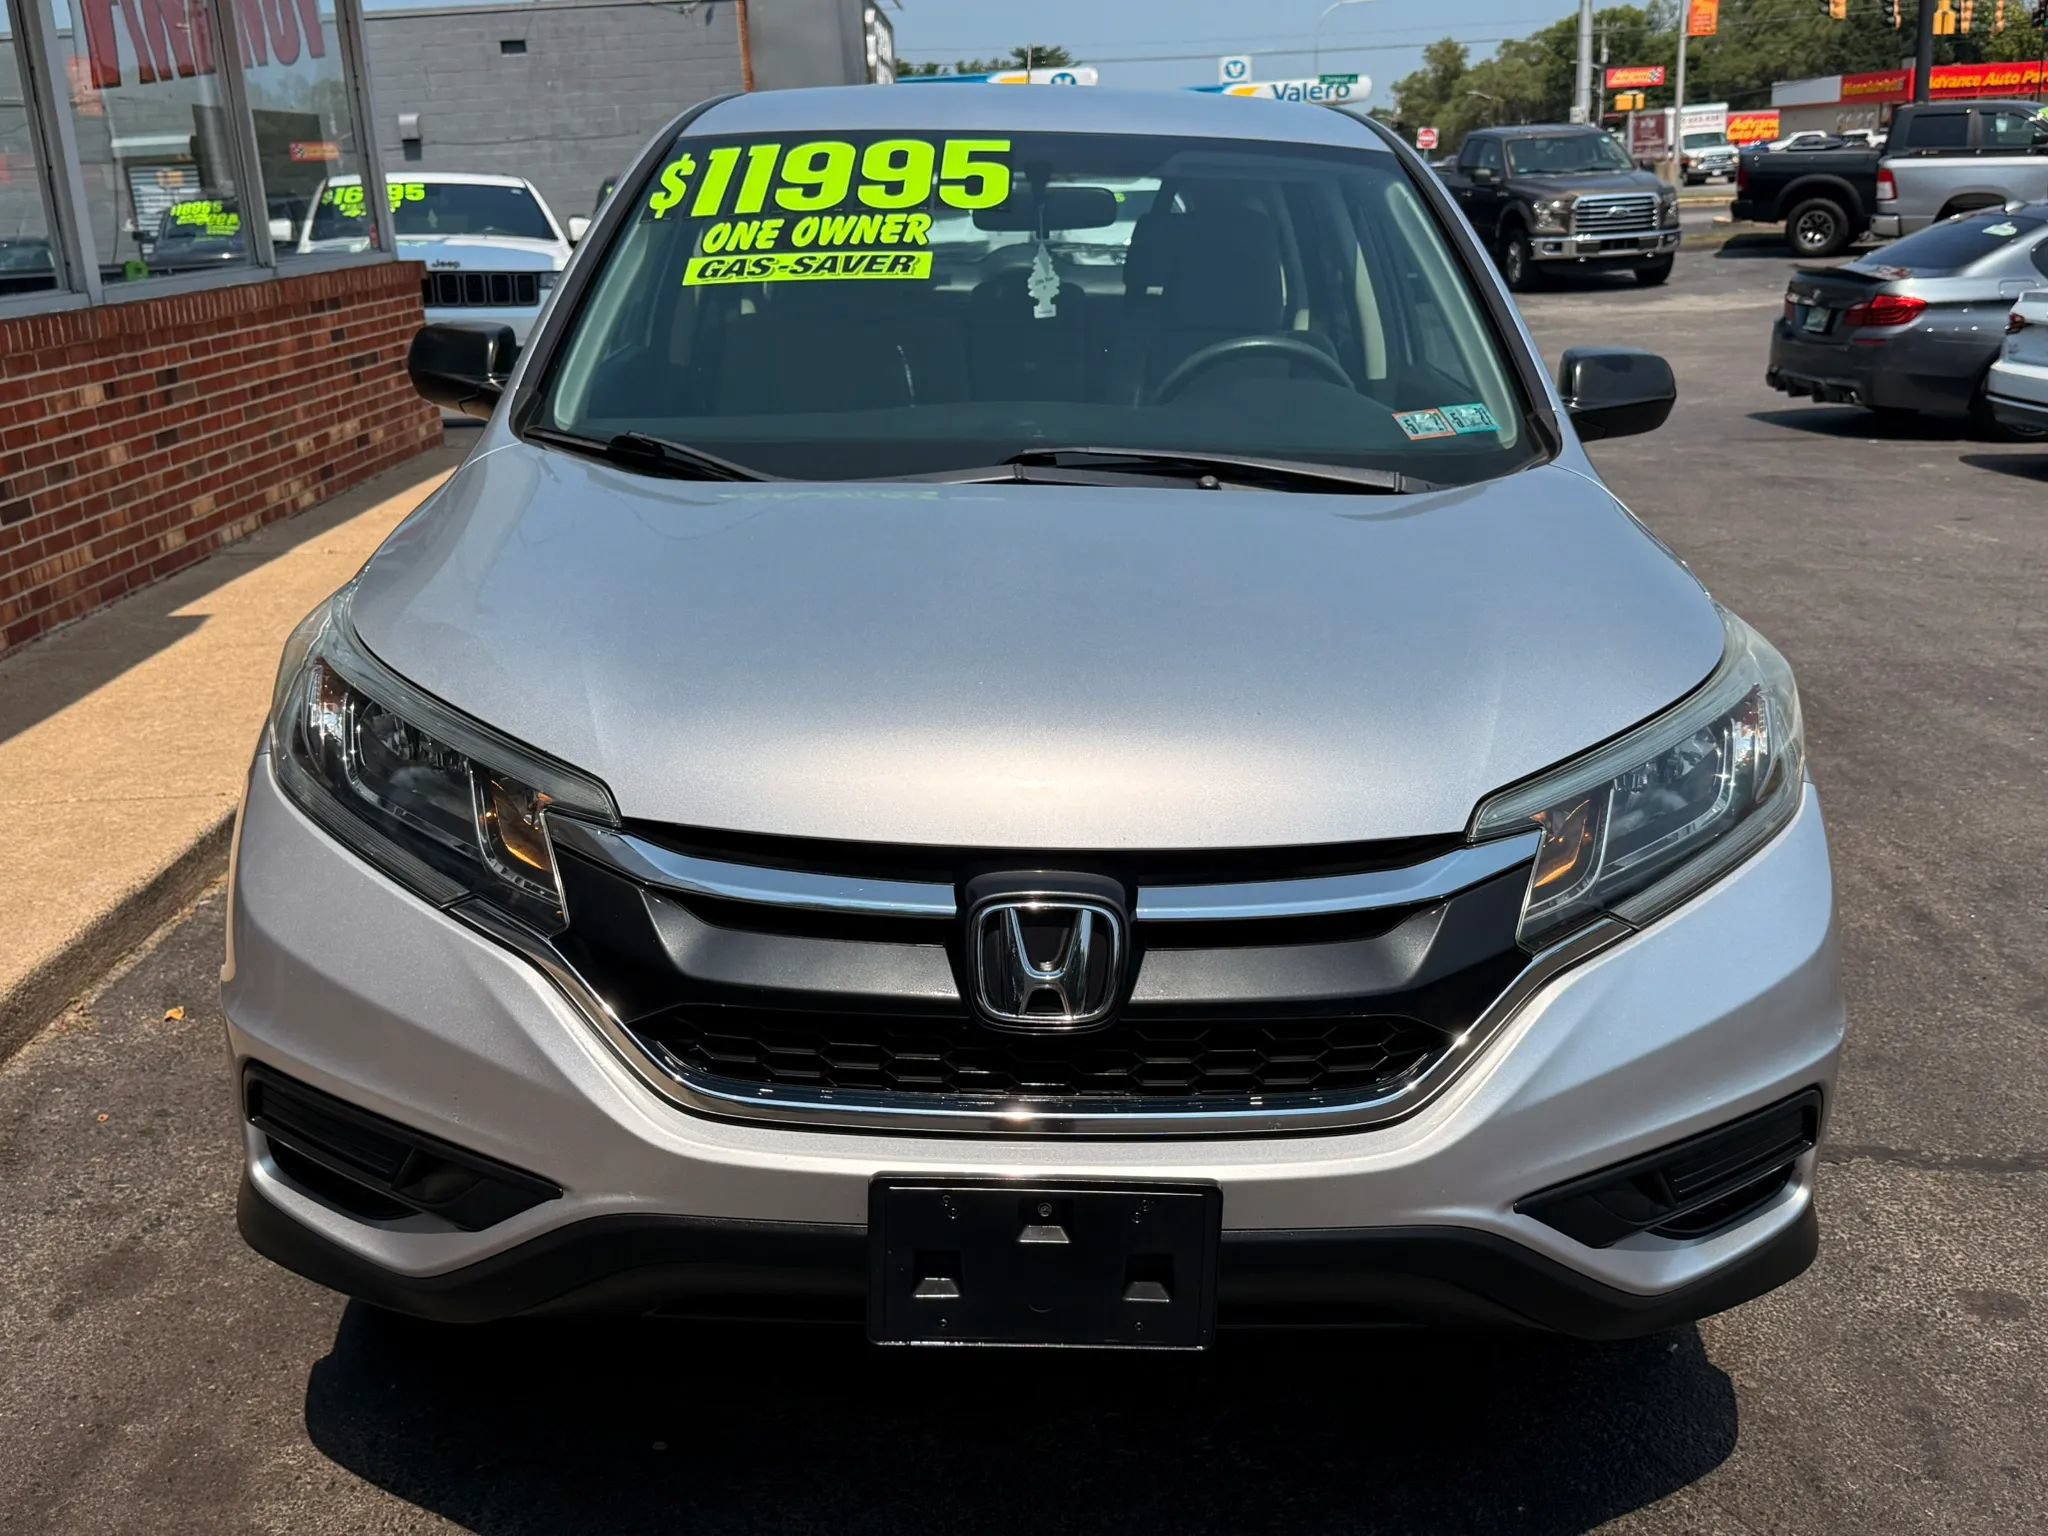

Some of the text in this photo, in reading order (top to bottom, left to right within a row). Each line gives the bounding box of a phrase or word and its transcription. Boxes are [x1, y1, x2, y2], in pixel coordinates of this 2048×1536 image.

[1271, 82, 1350, 102] Valero
[649, 139, 1011, 220] $11995
[321, 182, 426, 206] $1695
[702, 213, 932, 254] ONE OWNER
[431, 259, 461, 269] Jeep
[696, 254, 918, 281] GAS-SAVER
